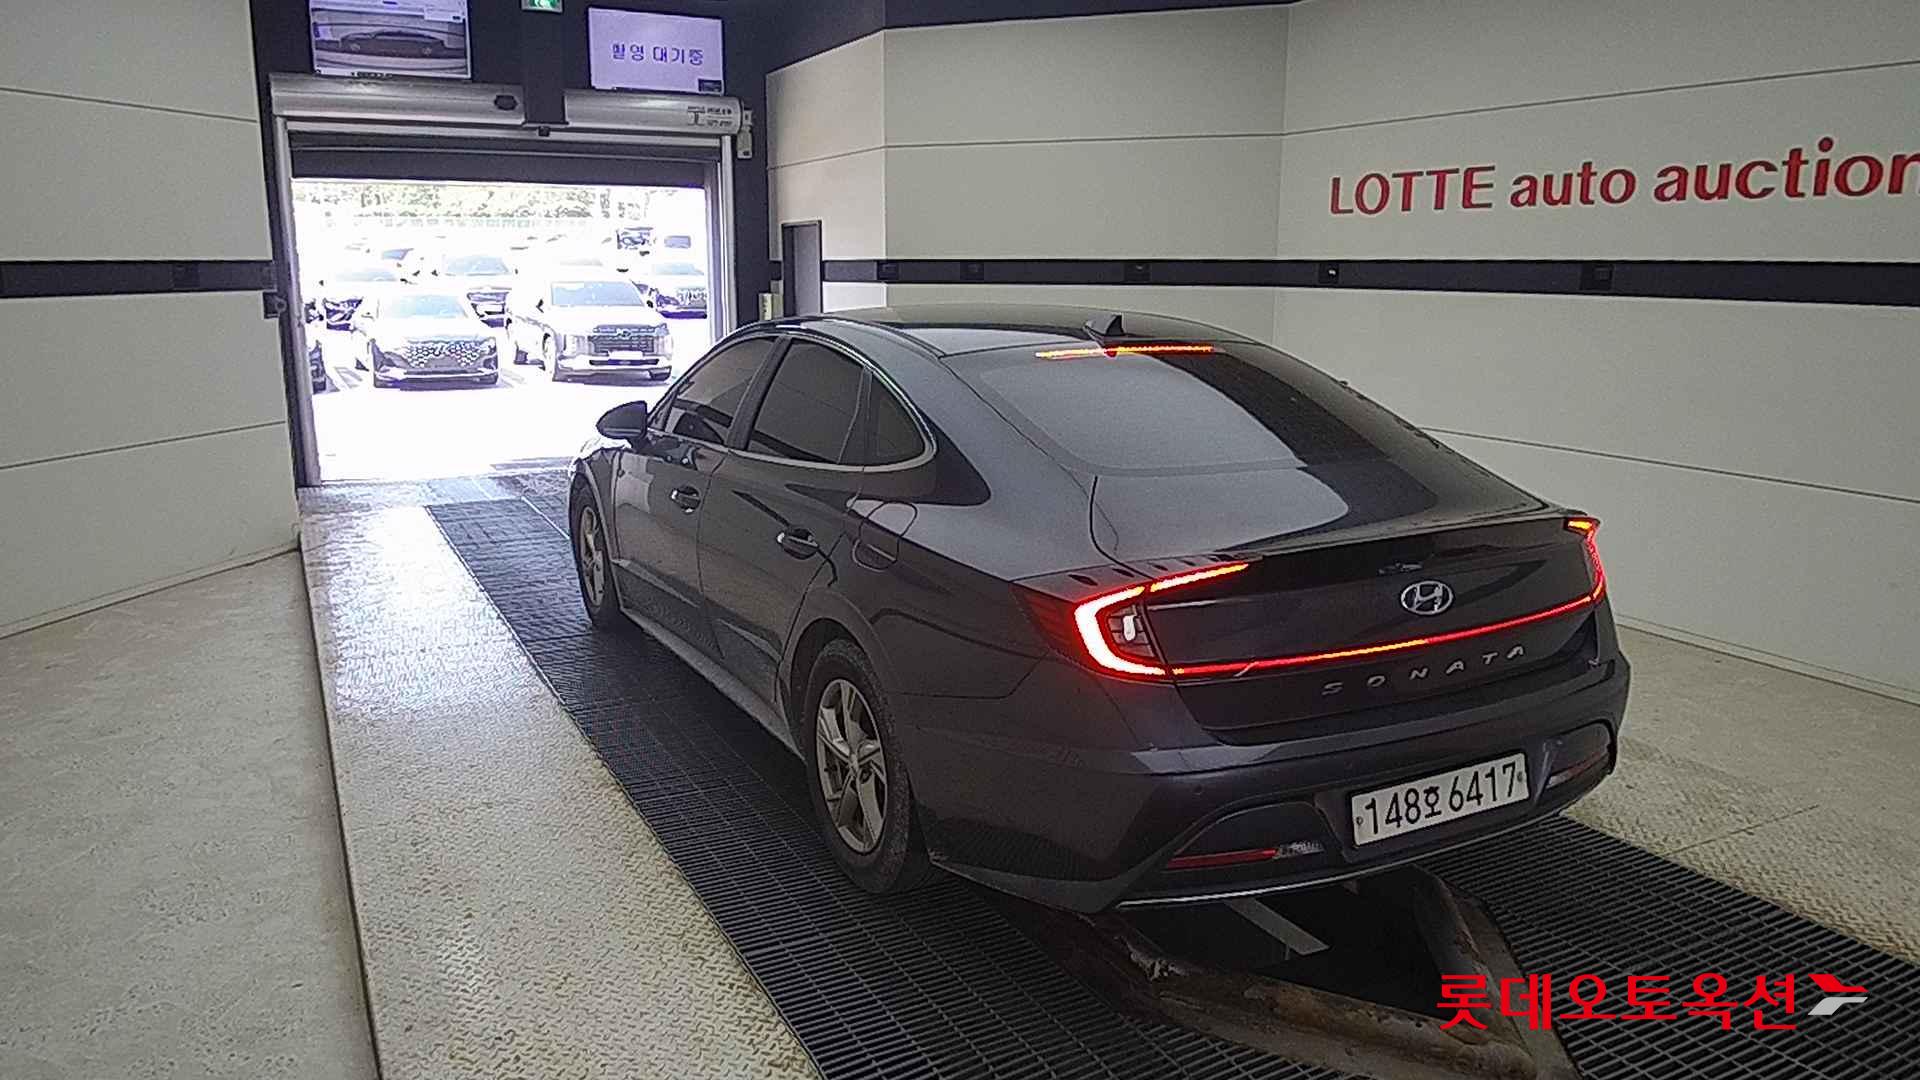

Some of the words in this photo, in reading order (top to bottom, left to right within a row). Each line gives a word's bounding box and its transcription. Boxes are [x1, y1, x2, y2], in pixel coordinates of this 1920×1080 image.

[652, 46, 704, 66] 대기중
[1330, 165, 1496, 215] LOTTE
[1510, 161, 1637, 208] auto
[1321, 645, 1525, 696] SONATA
